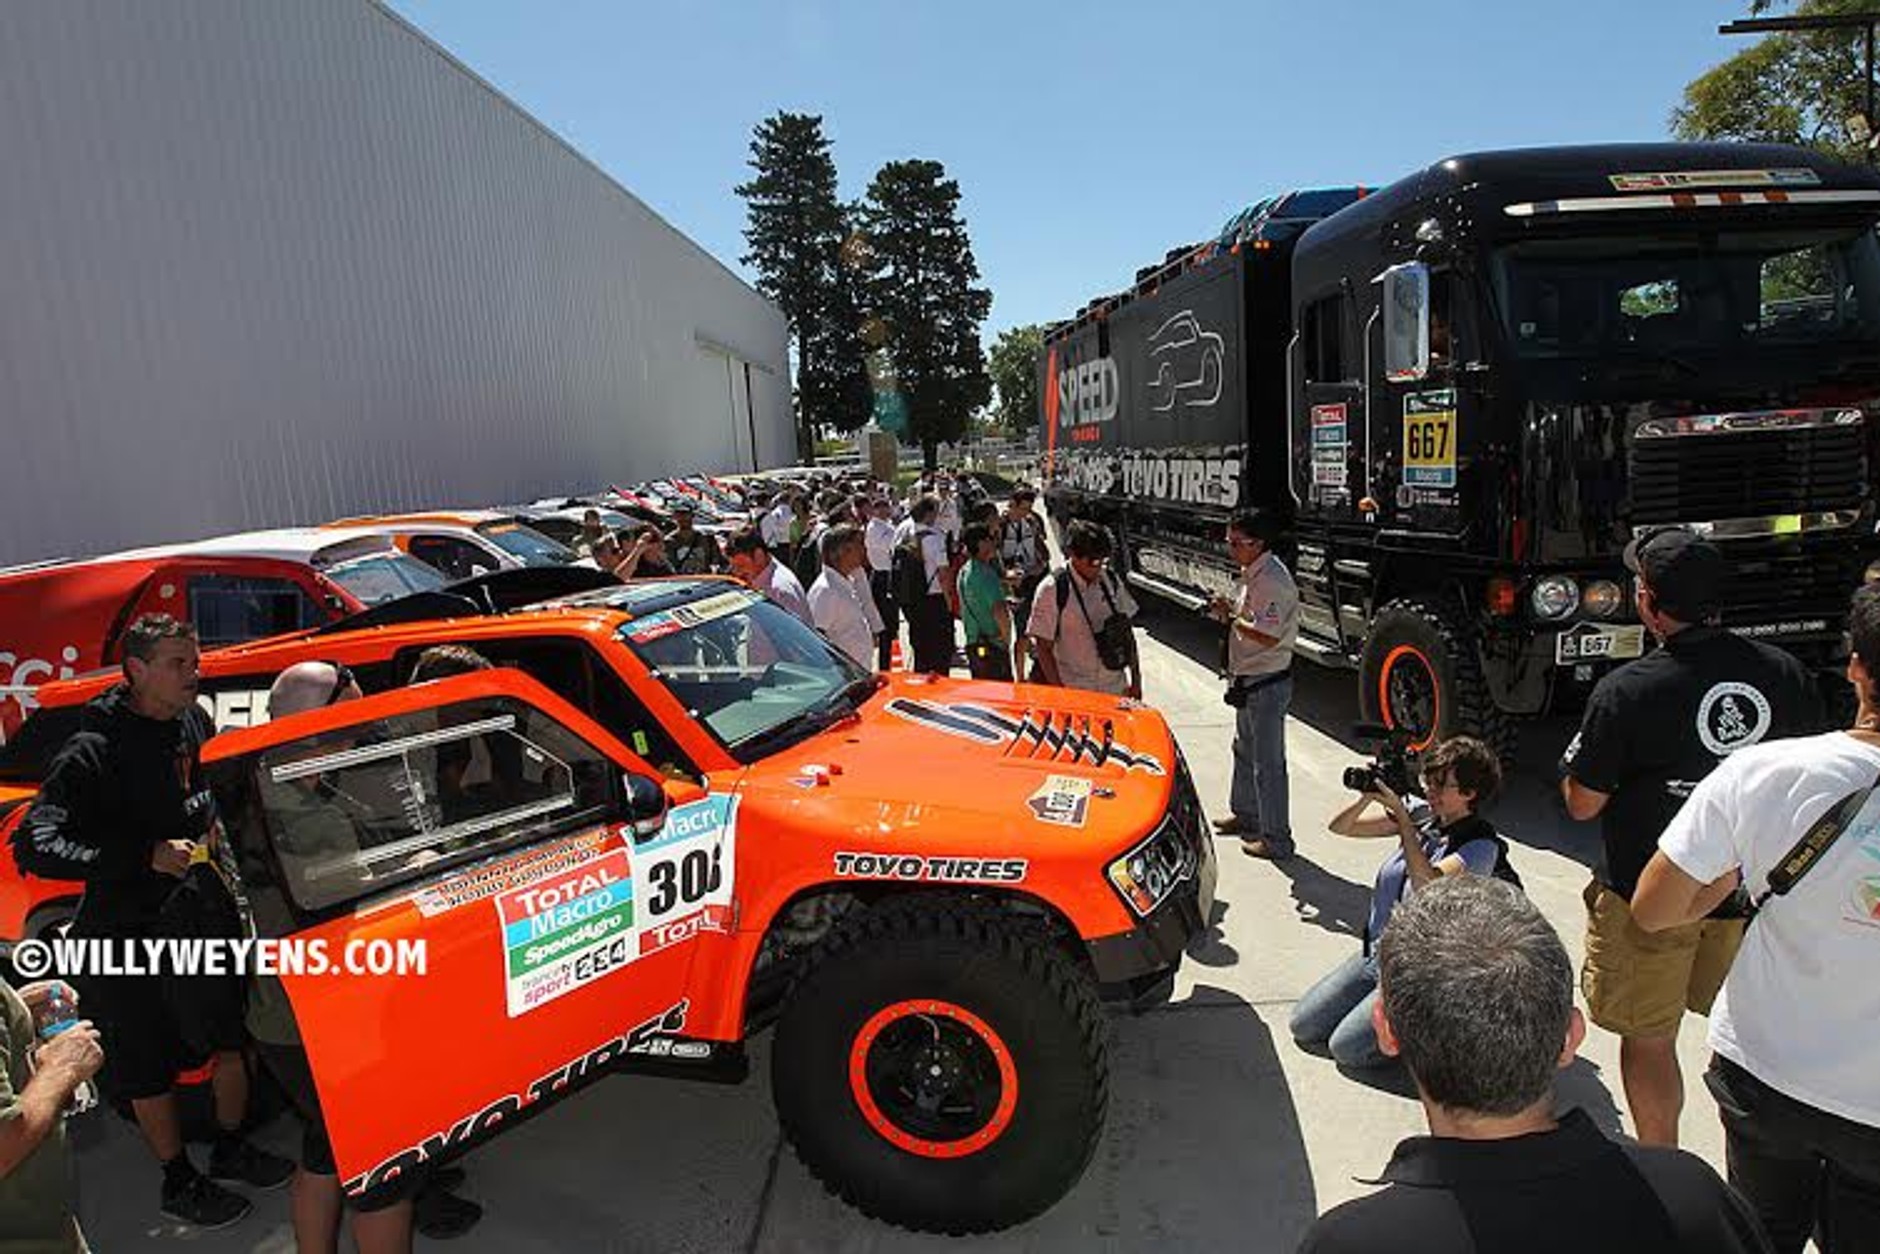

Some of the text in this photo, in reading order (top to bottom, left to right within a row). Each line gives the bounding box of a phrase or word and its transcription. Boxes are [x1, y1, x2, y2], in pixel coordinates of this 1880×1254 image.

[1058, 356, 1120, 428] SPEED
[1408, 421, 1449, 460] 667
[1122, 458, 1168, 499] TOYO
[1169, 459, 1241, 508] TIRES
[834, 852, 1028, 883] TOYO TIRES
[515, 869, 620, 916] TOTAL
[529, 889, 614, 941] Macro
[523, 913, 623, 966] SpeedAgro
[523, 973, 572, 1006] sport
